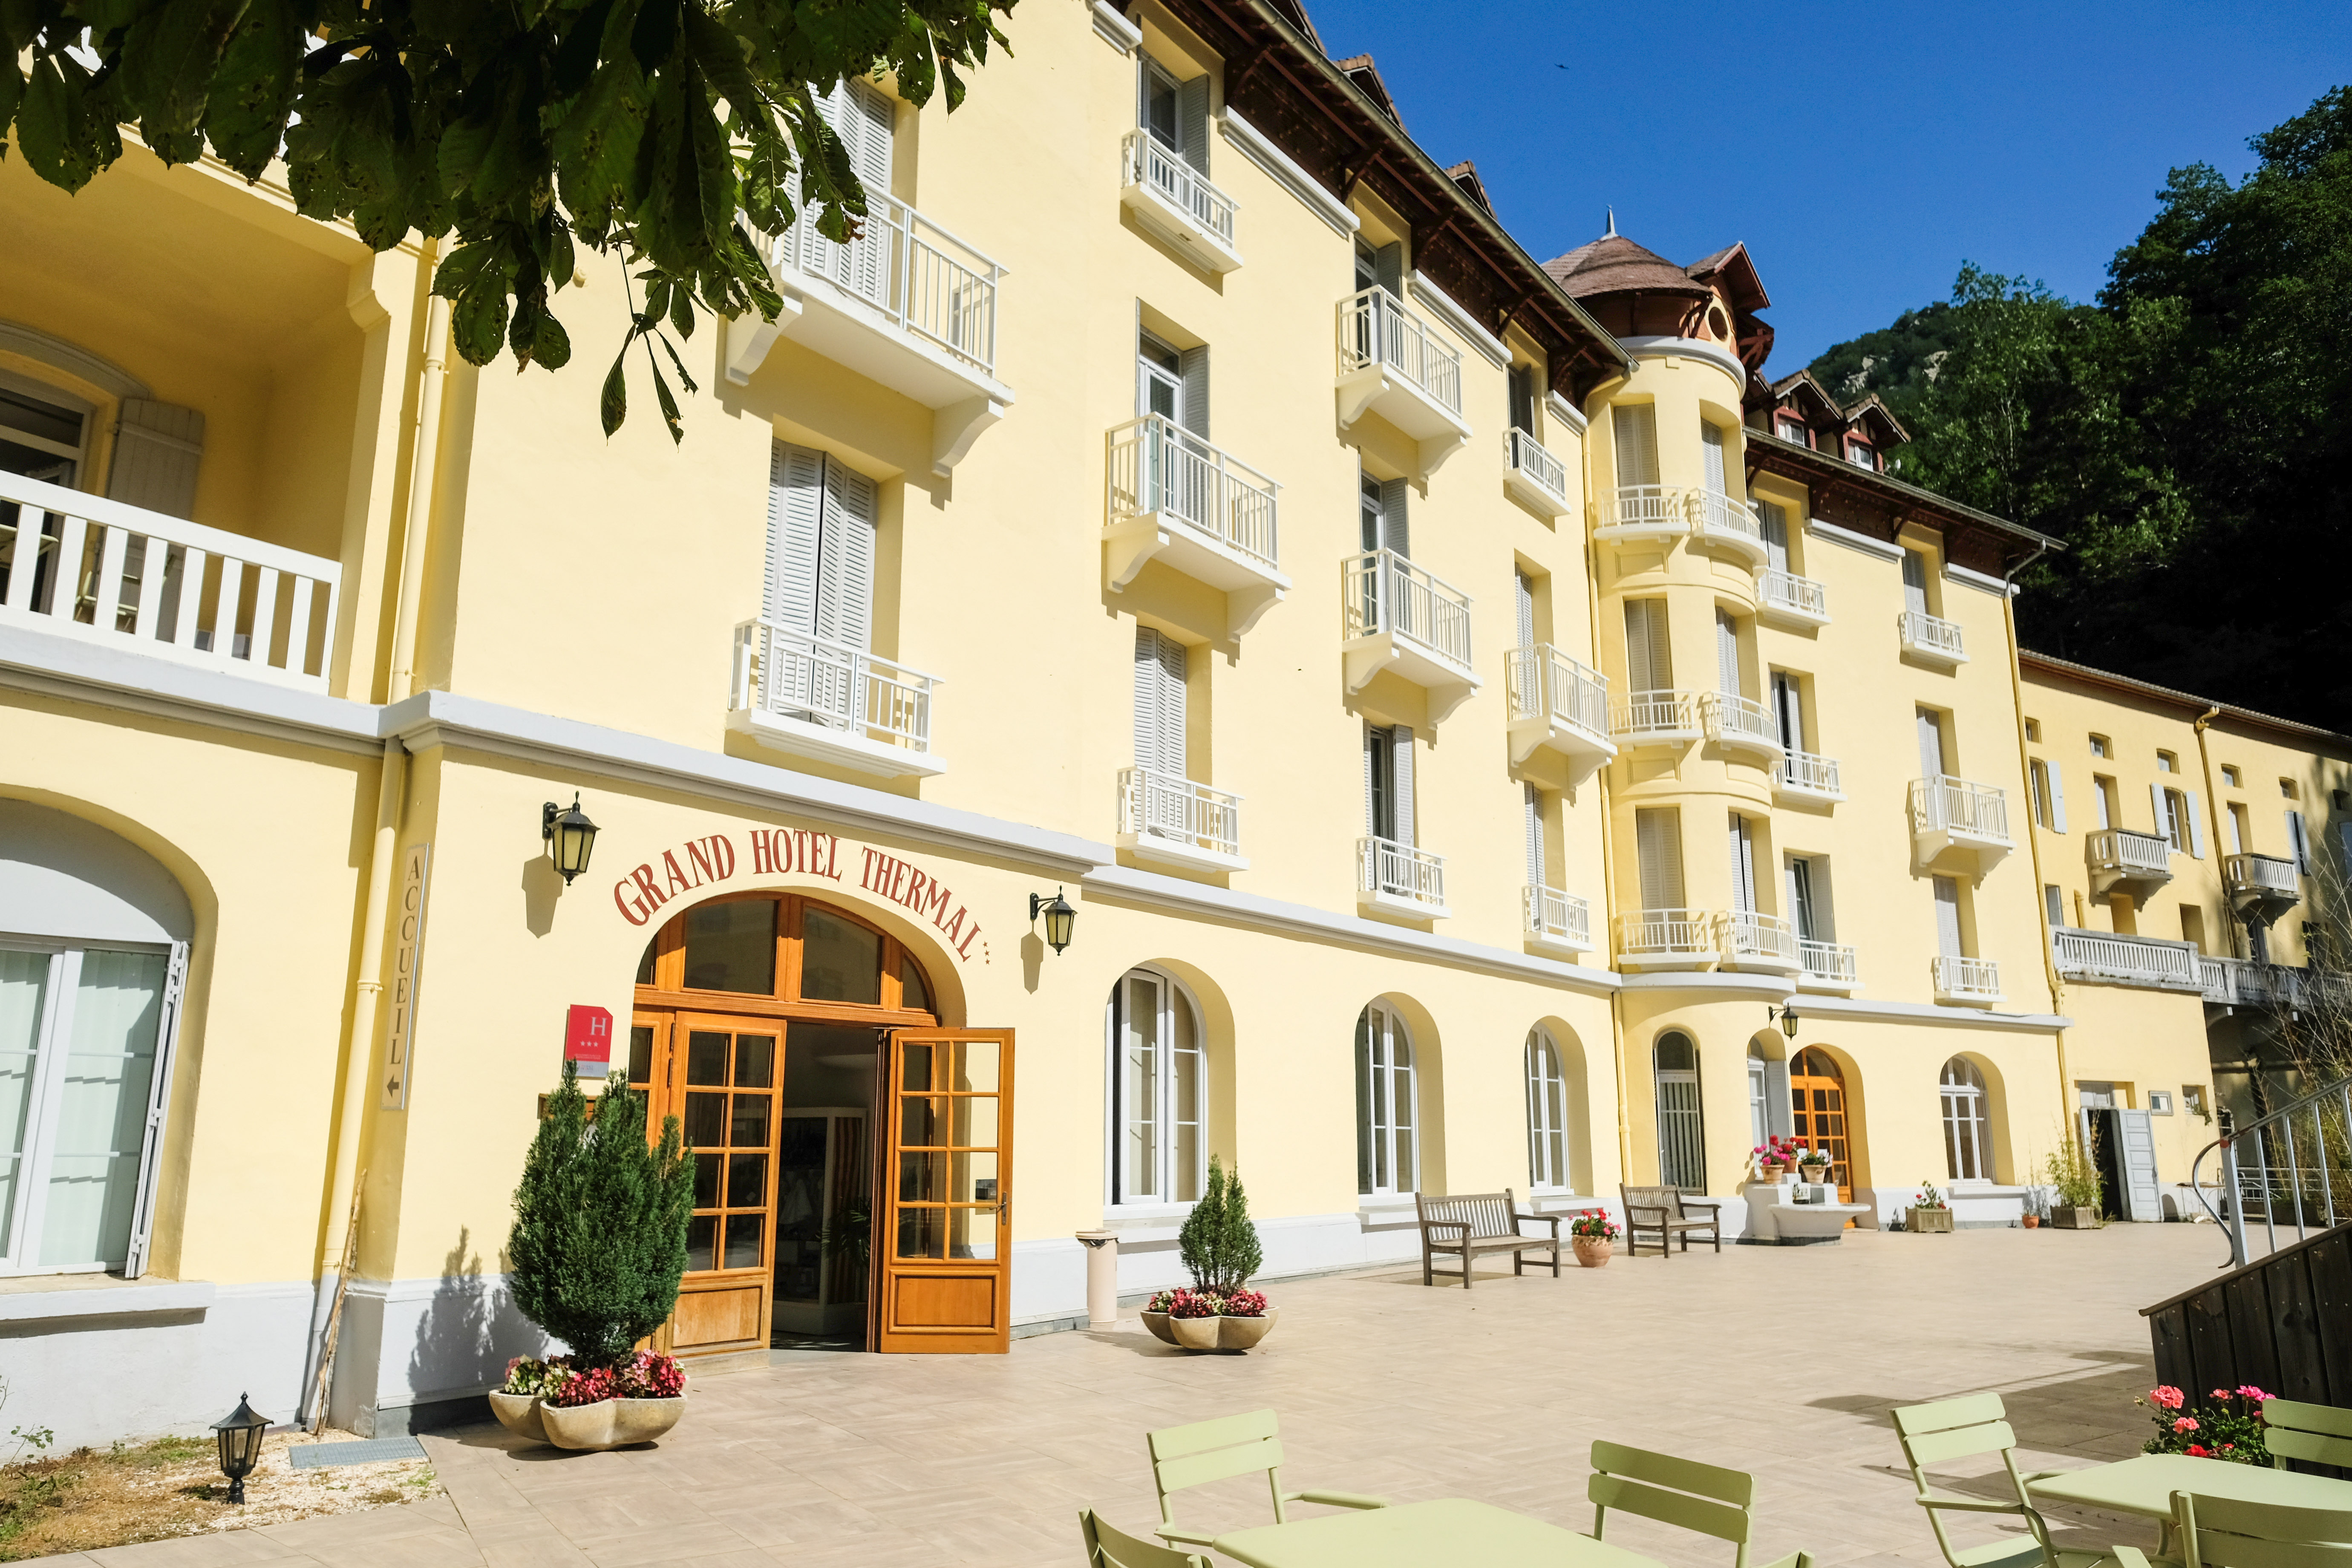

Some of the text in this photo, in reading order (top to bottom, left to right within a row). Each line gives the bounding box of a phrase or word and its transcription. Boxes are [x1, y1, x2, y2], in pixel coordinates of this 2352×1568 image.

[389, 855, 420, 1065] ACCUEIL
[614, 828, 982, 962] GRAND HOTEL THERMAL
[591, 1017, 607, 1036] H
